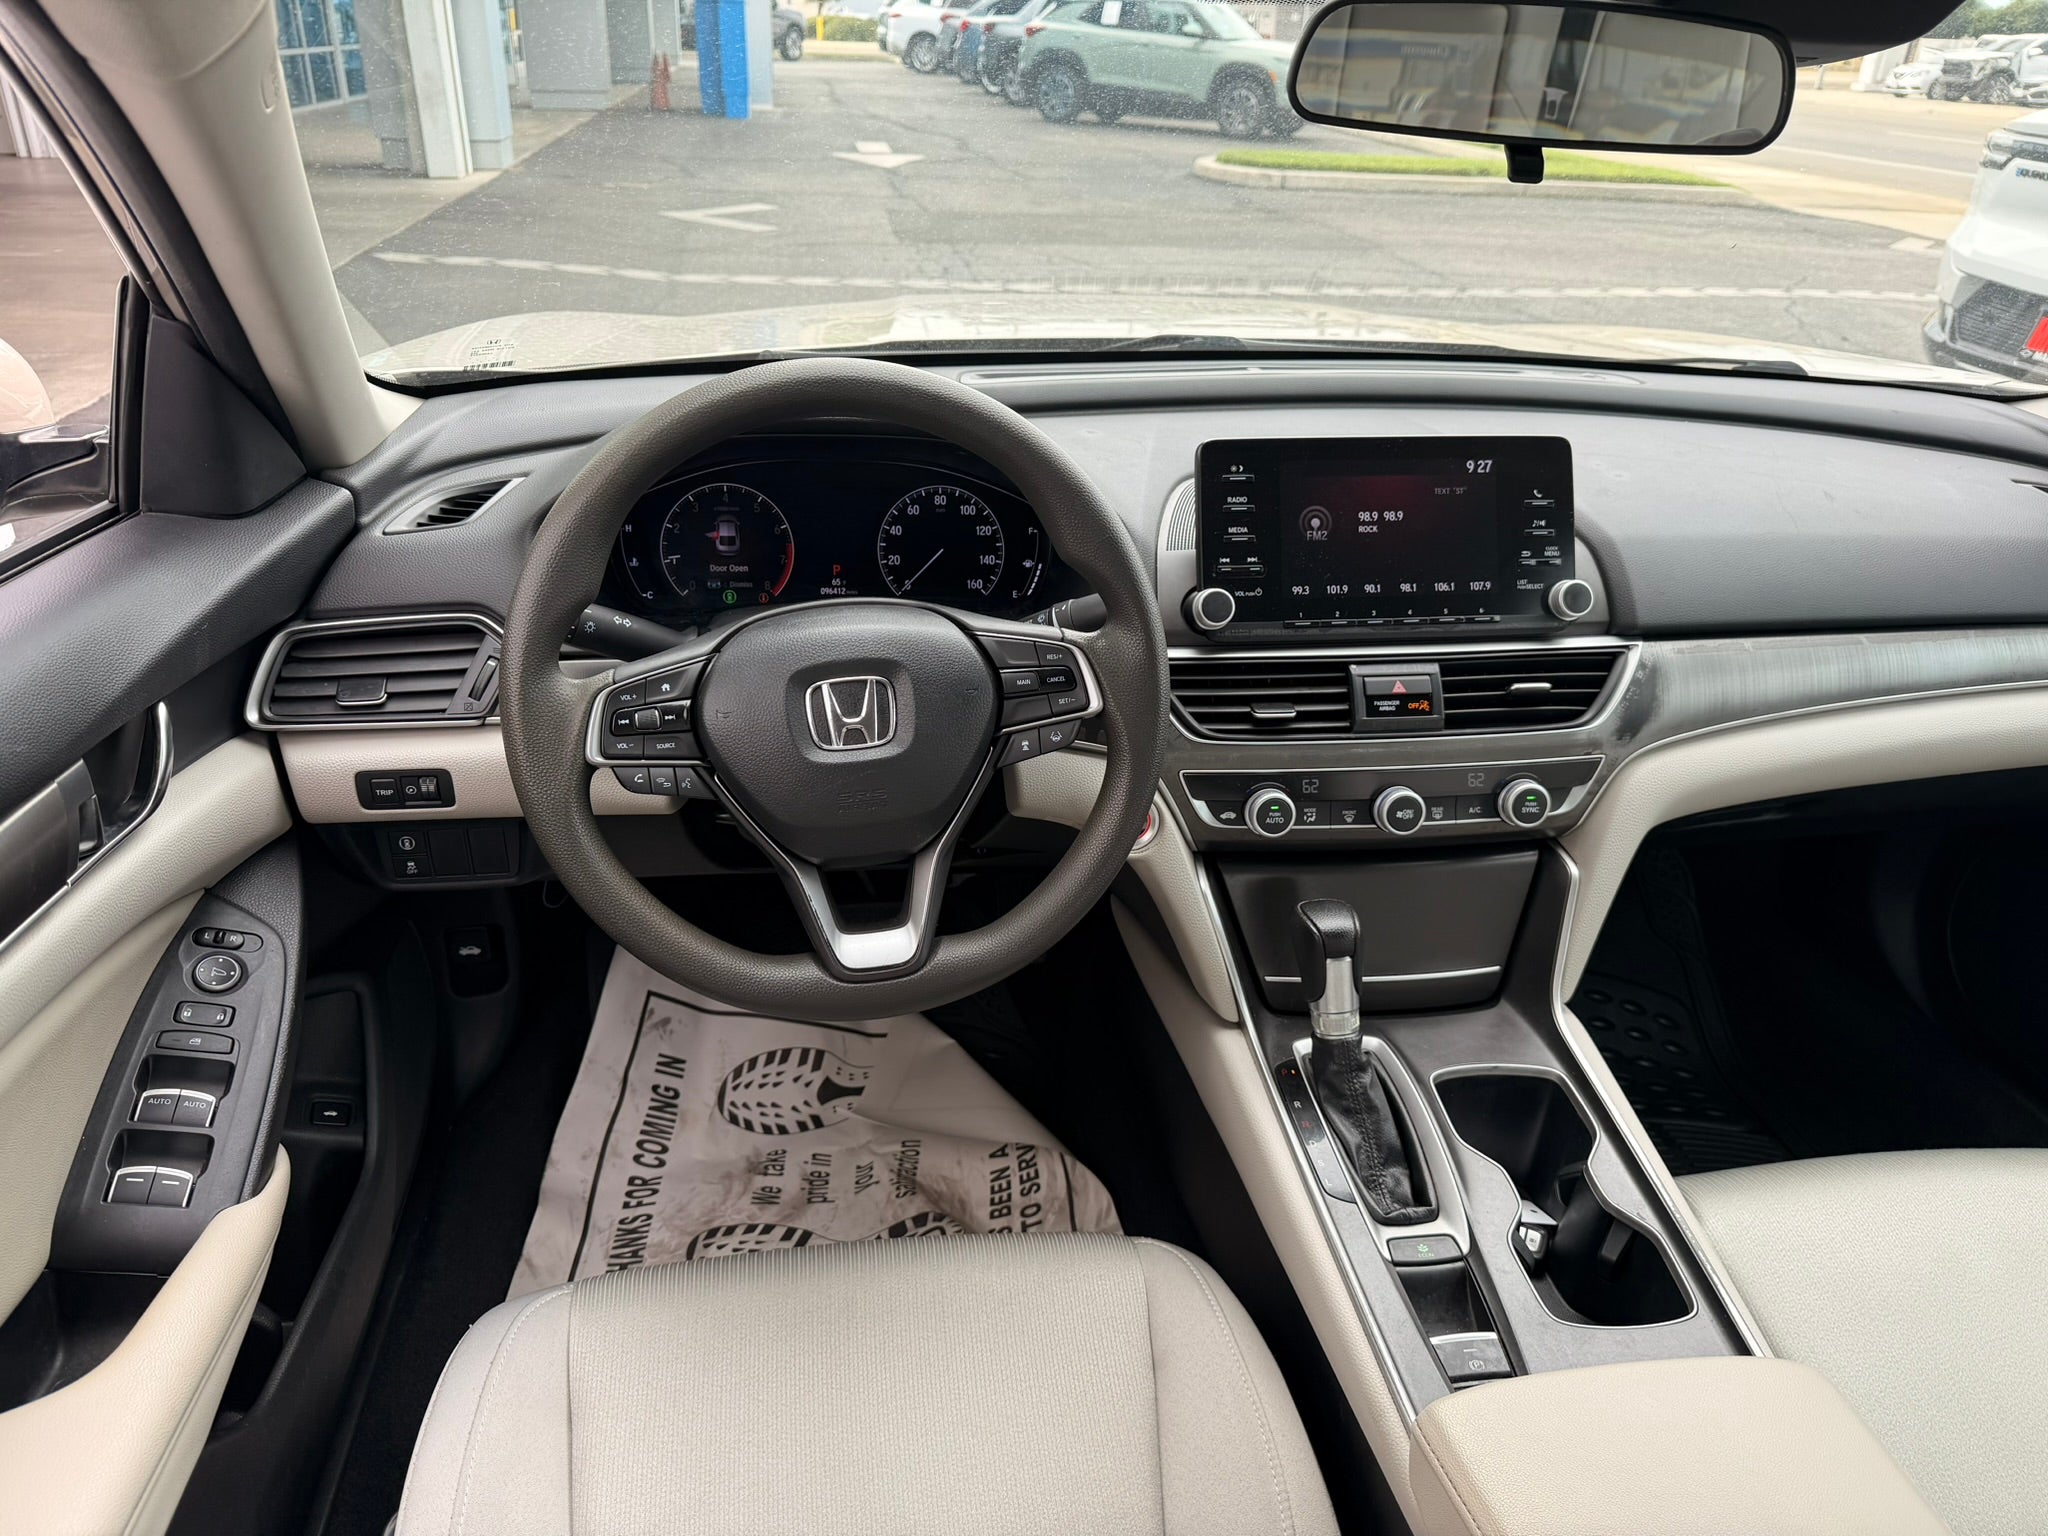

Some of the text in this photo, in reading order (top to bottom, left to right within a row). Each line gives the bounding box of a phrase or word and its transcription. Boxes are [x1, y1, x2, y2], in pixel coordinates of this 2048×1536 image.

[1434, 487, 1450, 495] TEXT
[934, 495, 946, 505] 80
[754, 502, 760, 513] 5
[907, 504, 920, 515] 60
[960, 504, 976, 515] 100
[1358, 511, 1404, 521] 98.9 98.9
[625, 524, 632, 532] H
[673, 523, 680, 533] 2
[774, 525, 780, 534] 6
[890, 525, 902, 535] 40
[976, 525, 992, 535] 120
[1028, 527, 1033, 535] F
[1358, 525, 1378, 533] ROCK
[1307, 530, 1328, 541] FM2
[888, 555, 900, 565] 20
[979, 555, 995, 565] 140
[729, 565, 749, 573] Open
[832, 564, 841, 576] P
[832, 578, 841, 586] 65
[967, 579, 983, 589] 160
[1434, 582, 1455, 592] 106.1
[1469, 581, 1491, 591] 107.9
[820, 587, 846, 595] 096412
[1291, 585, 1310, 595] 99.3
[1326, 584, 1348, 594] 101.9
[1364, 584, 1381, 593] 90.1
[1399, 583, 1417, 592] 98.1
[647, 591, 654, 599] C
[1012, 590, 1018, 598] E
[1468, 773, 1485, 787] 62
[1302, 779, 1319, 794] 62
[1469, 806, 1481, 814] A/C
[1521, 806, 1540, 814] SYNC
[204, 932, 237, 943] L R
[148, 1097, 172, 1106] AUTO
[183, 1100, 207, 1109] AUTO
[1293, 1100, 1302, 1109] R
[988, 1143, 1009, 1159] A
[606, 1053, 687, 1273] HANKS FOR COMING IN
[889, 1139, 922, 1199] satifaction
[751, 1148, 788, 1205] We take
[801, 1152, 835, 1205] pride in
[854, 1160, 880, 1196] your
[989, 1165, 1012, 1220] BEEN
[1015, 1143, 1043, 1233] TO SERV
